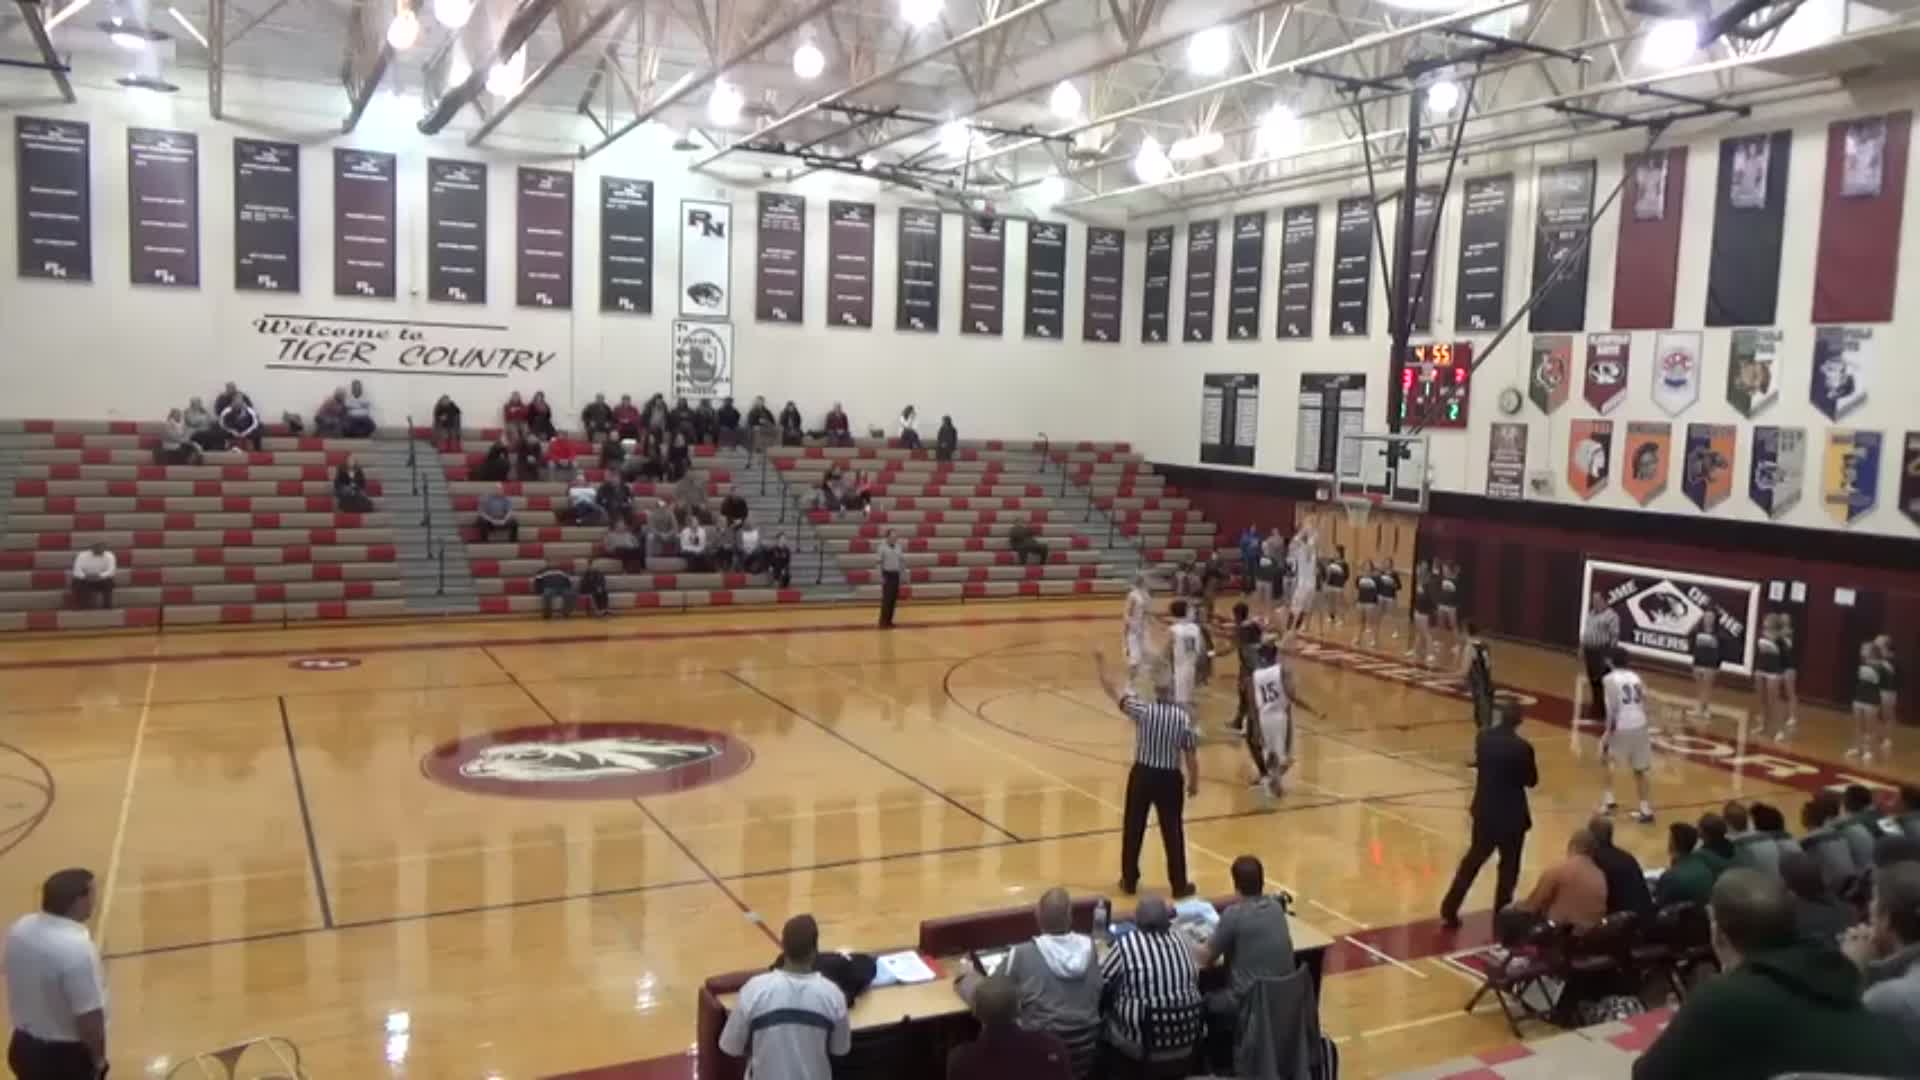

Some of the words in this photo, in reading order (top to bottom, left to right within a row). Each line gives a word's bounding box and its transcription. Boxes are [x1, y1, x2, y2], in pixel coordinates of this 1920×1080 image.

[252, 318, 391, 340] Welcome
[399, 326, 424, 341] to
[277, 337, 377, 365] TIGER
[399, 343, 556, 371] COUNTRY
[1633, 630, 1689, 651] TIGERS
[1259, 681, 1279, 703] 15
